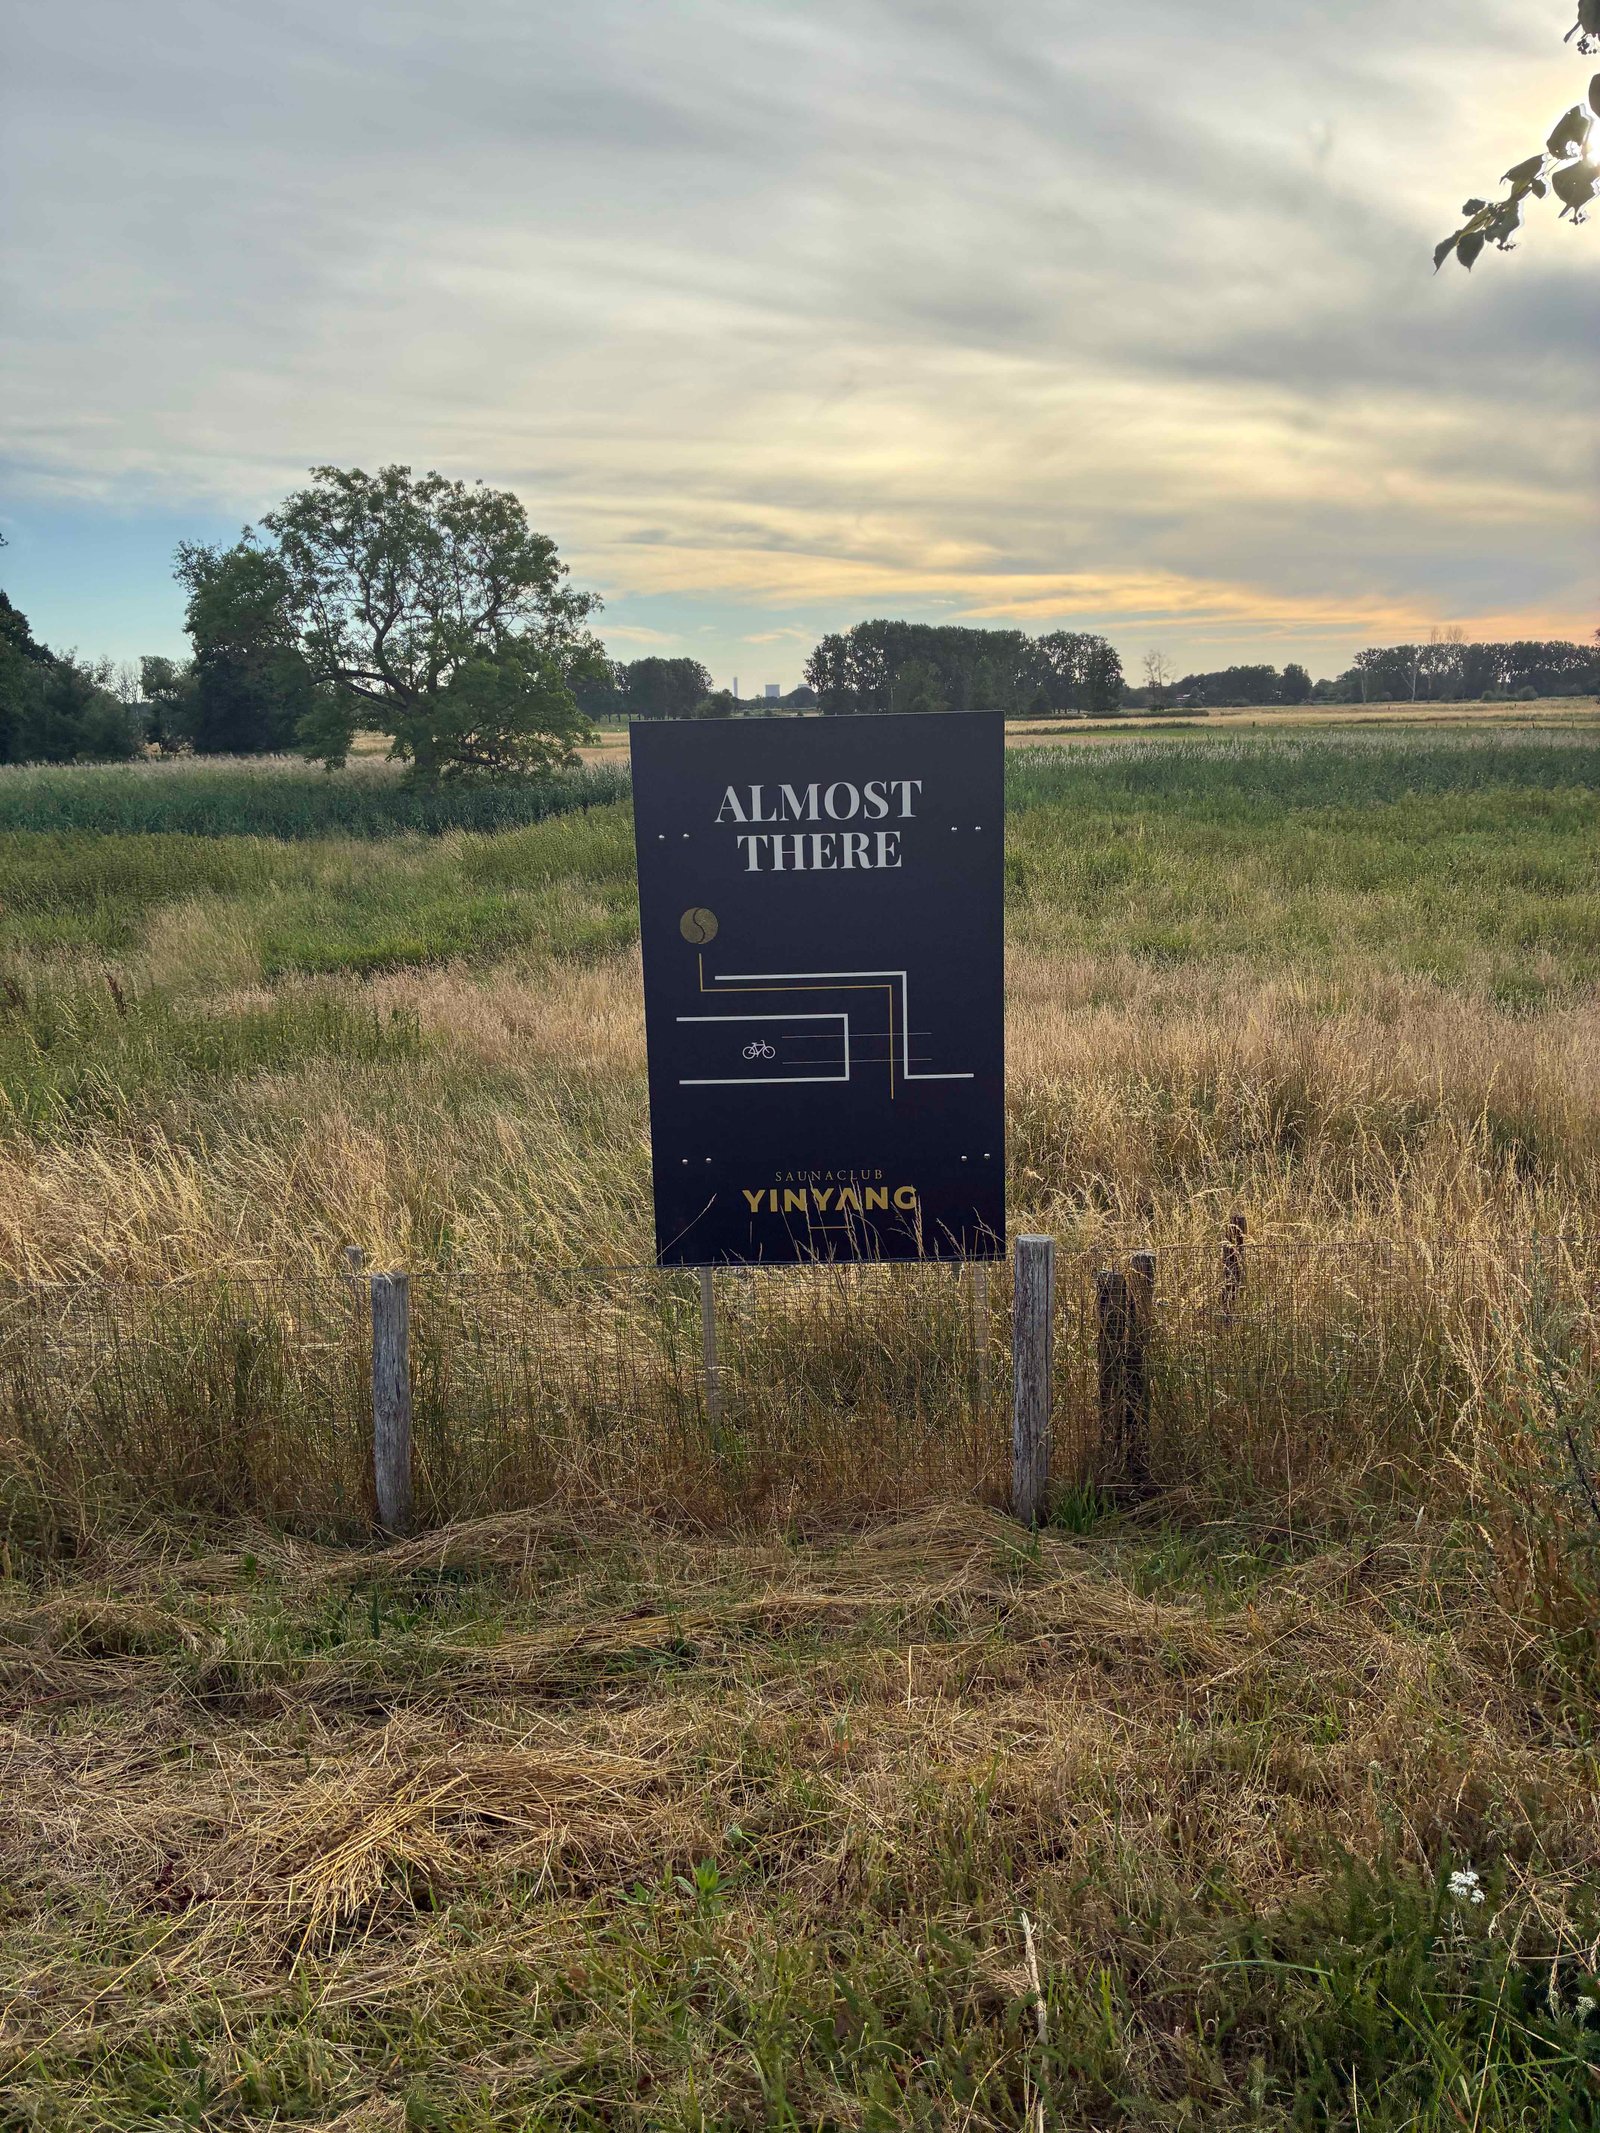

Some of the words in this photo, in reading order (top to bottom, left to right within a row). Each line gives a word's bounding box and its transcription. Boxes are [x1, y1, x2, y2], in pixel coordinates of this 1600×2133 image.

[714, 780, 922, 823] ALMOST
[736, 831, 902, 871] THERE
[775, 1169, 883, 1182] SAUNACLUB
[742, 1186, 917, 1213] YINYANG
